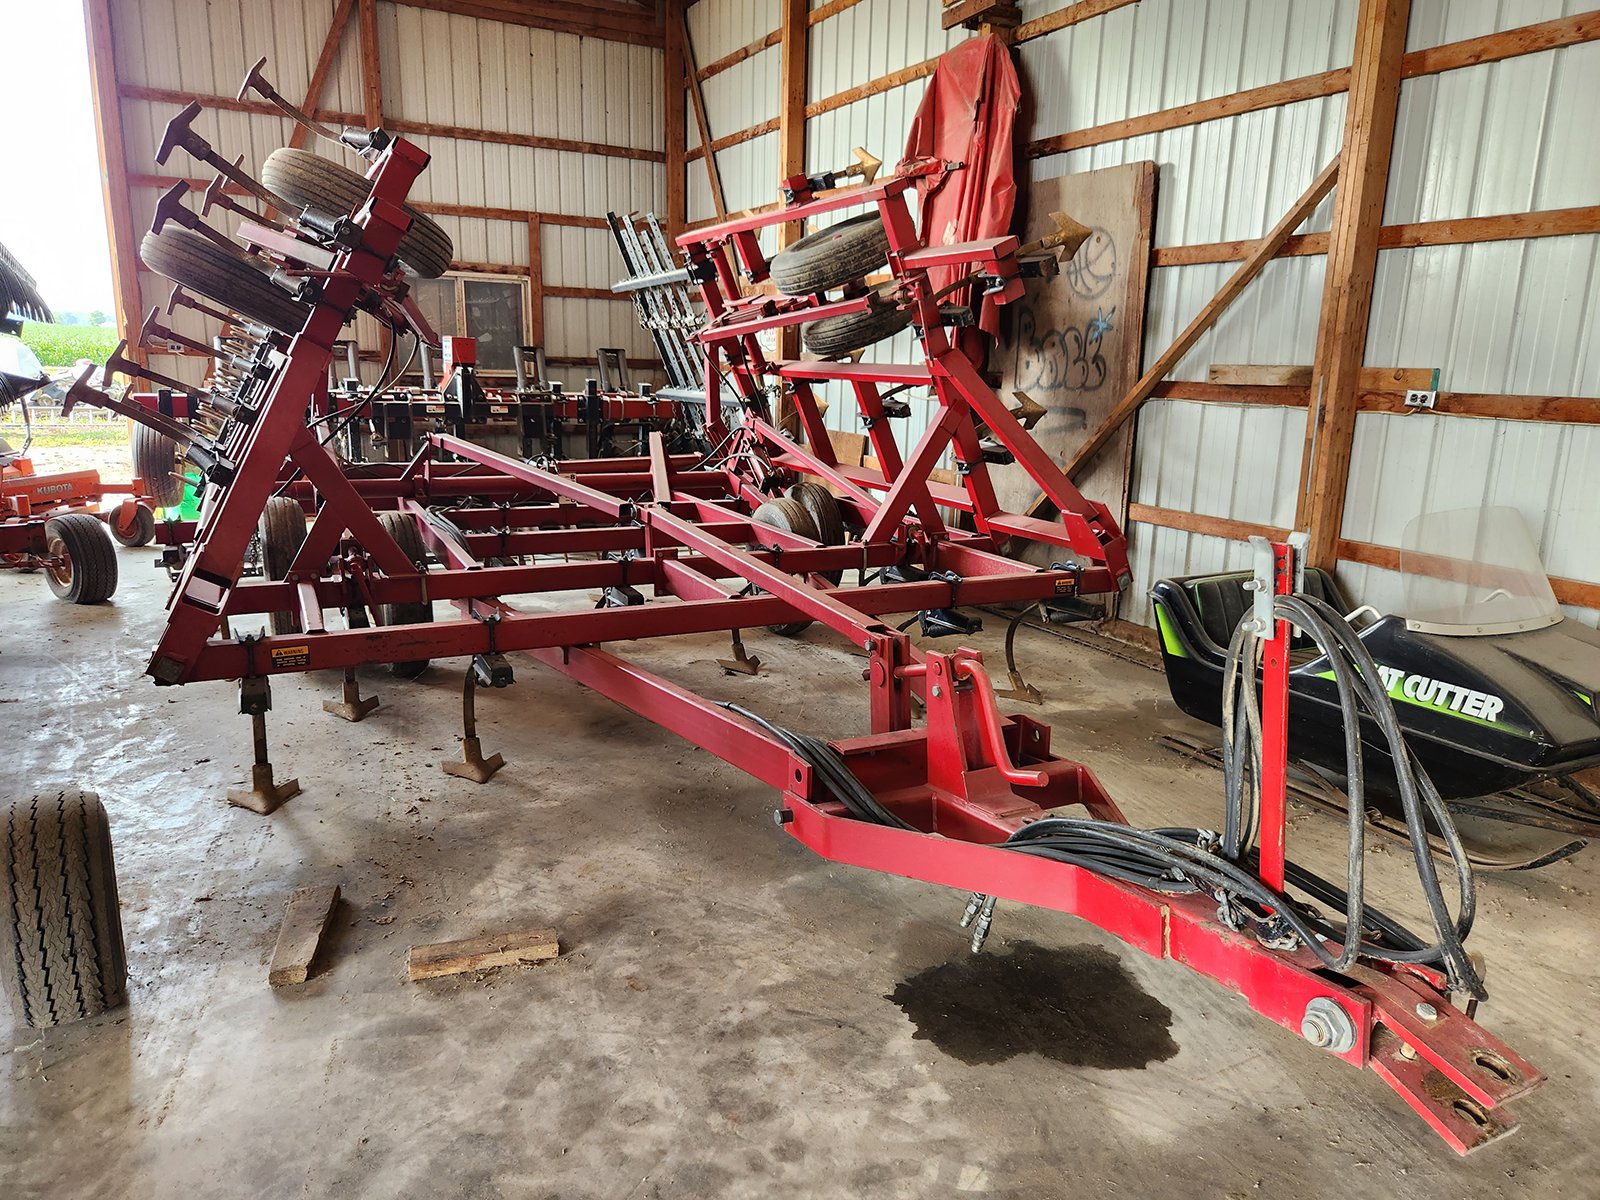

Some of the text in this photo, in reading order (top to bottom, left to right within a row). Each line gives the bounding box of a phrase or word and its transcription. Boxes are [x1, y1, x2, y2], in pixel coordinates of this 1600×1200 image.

[36, 483, 73, 494] KUBOTA
[1361, 663, 1504, 722] AT CUTTER
